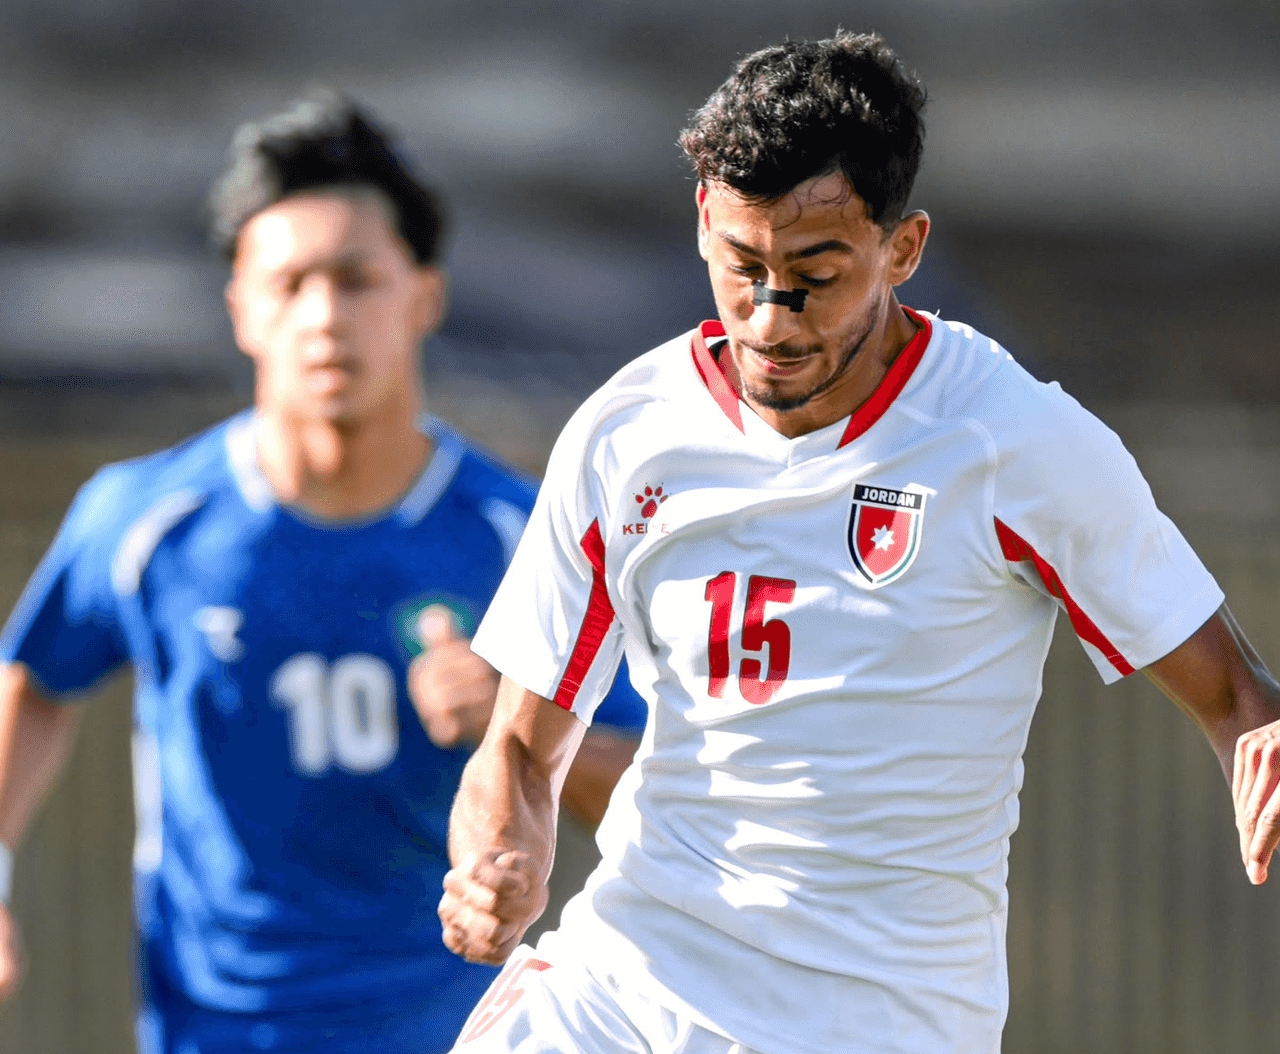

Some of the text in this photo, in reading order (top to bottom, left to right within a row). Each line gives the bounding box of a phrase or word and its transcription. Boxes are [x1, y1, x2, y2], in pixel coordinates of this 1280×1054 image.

[861, 487, 916, 508] JORDAN
[703, 570, 797, 705] 15
[271, 652, 398, 775] 10
